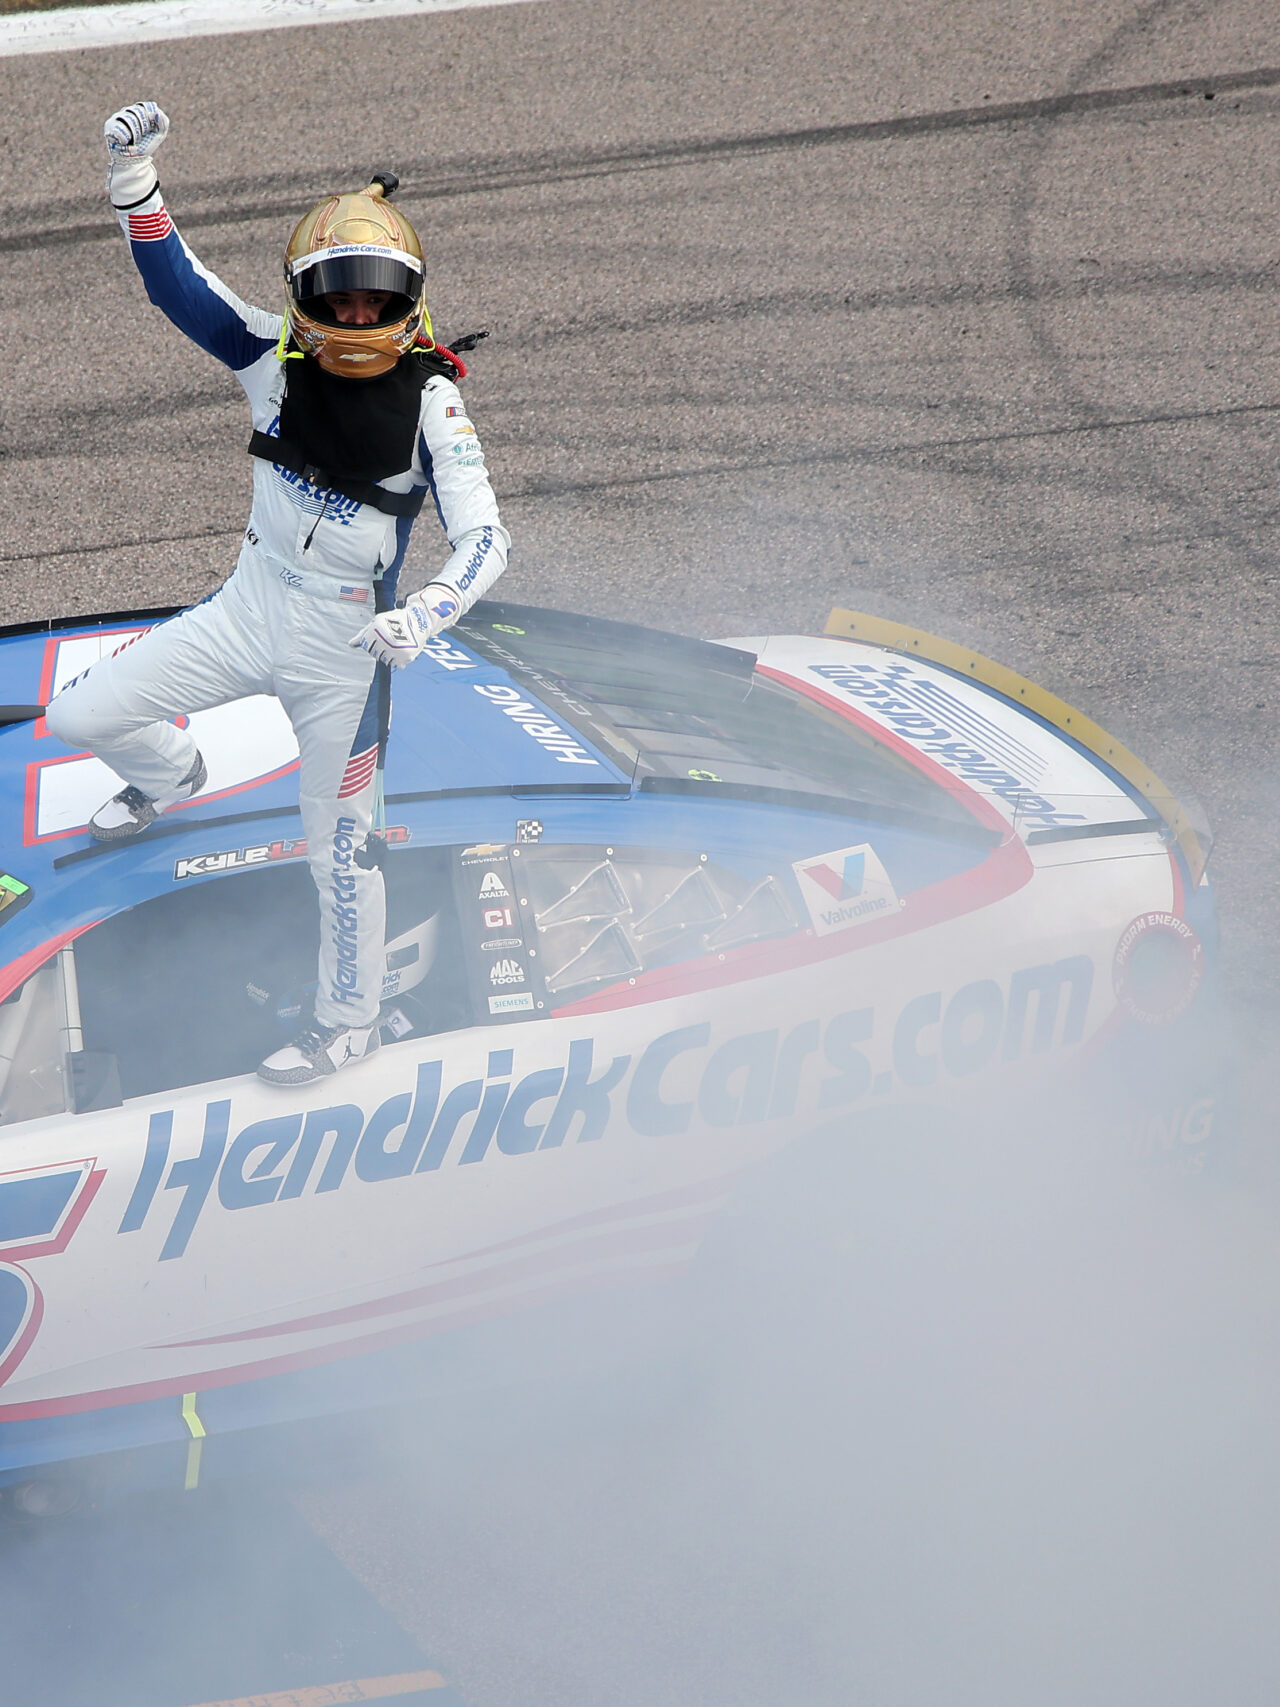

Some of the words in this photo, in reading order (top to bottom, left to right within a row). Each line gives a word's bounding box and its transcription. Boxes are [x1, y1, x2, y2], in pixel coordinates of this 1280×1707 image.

[327, 246, 359, 257] Hendrick
[457, 624, 593, 718] CHEVROLET
[473, 684, 600, 766] HIRING
[461, 856, 509, 866] CHEVROLET
[478, 889, 510, 900] AXALTA
[820, 897, 888, 926] Valvoline
[1147, 914, 1193, 938] ENERGY
[490, 959, 525, 980] MAC
[490, 974, 525, 986] TOOLS
[494, 998, 529, 1009] SIEMENS
